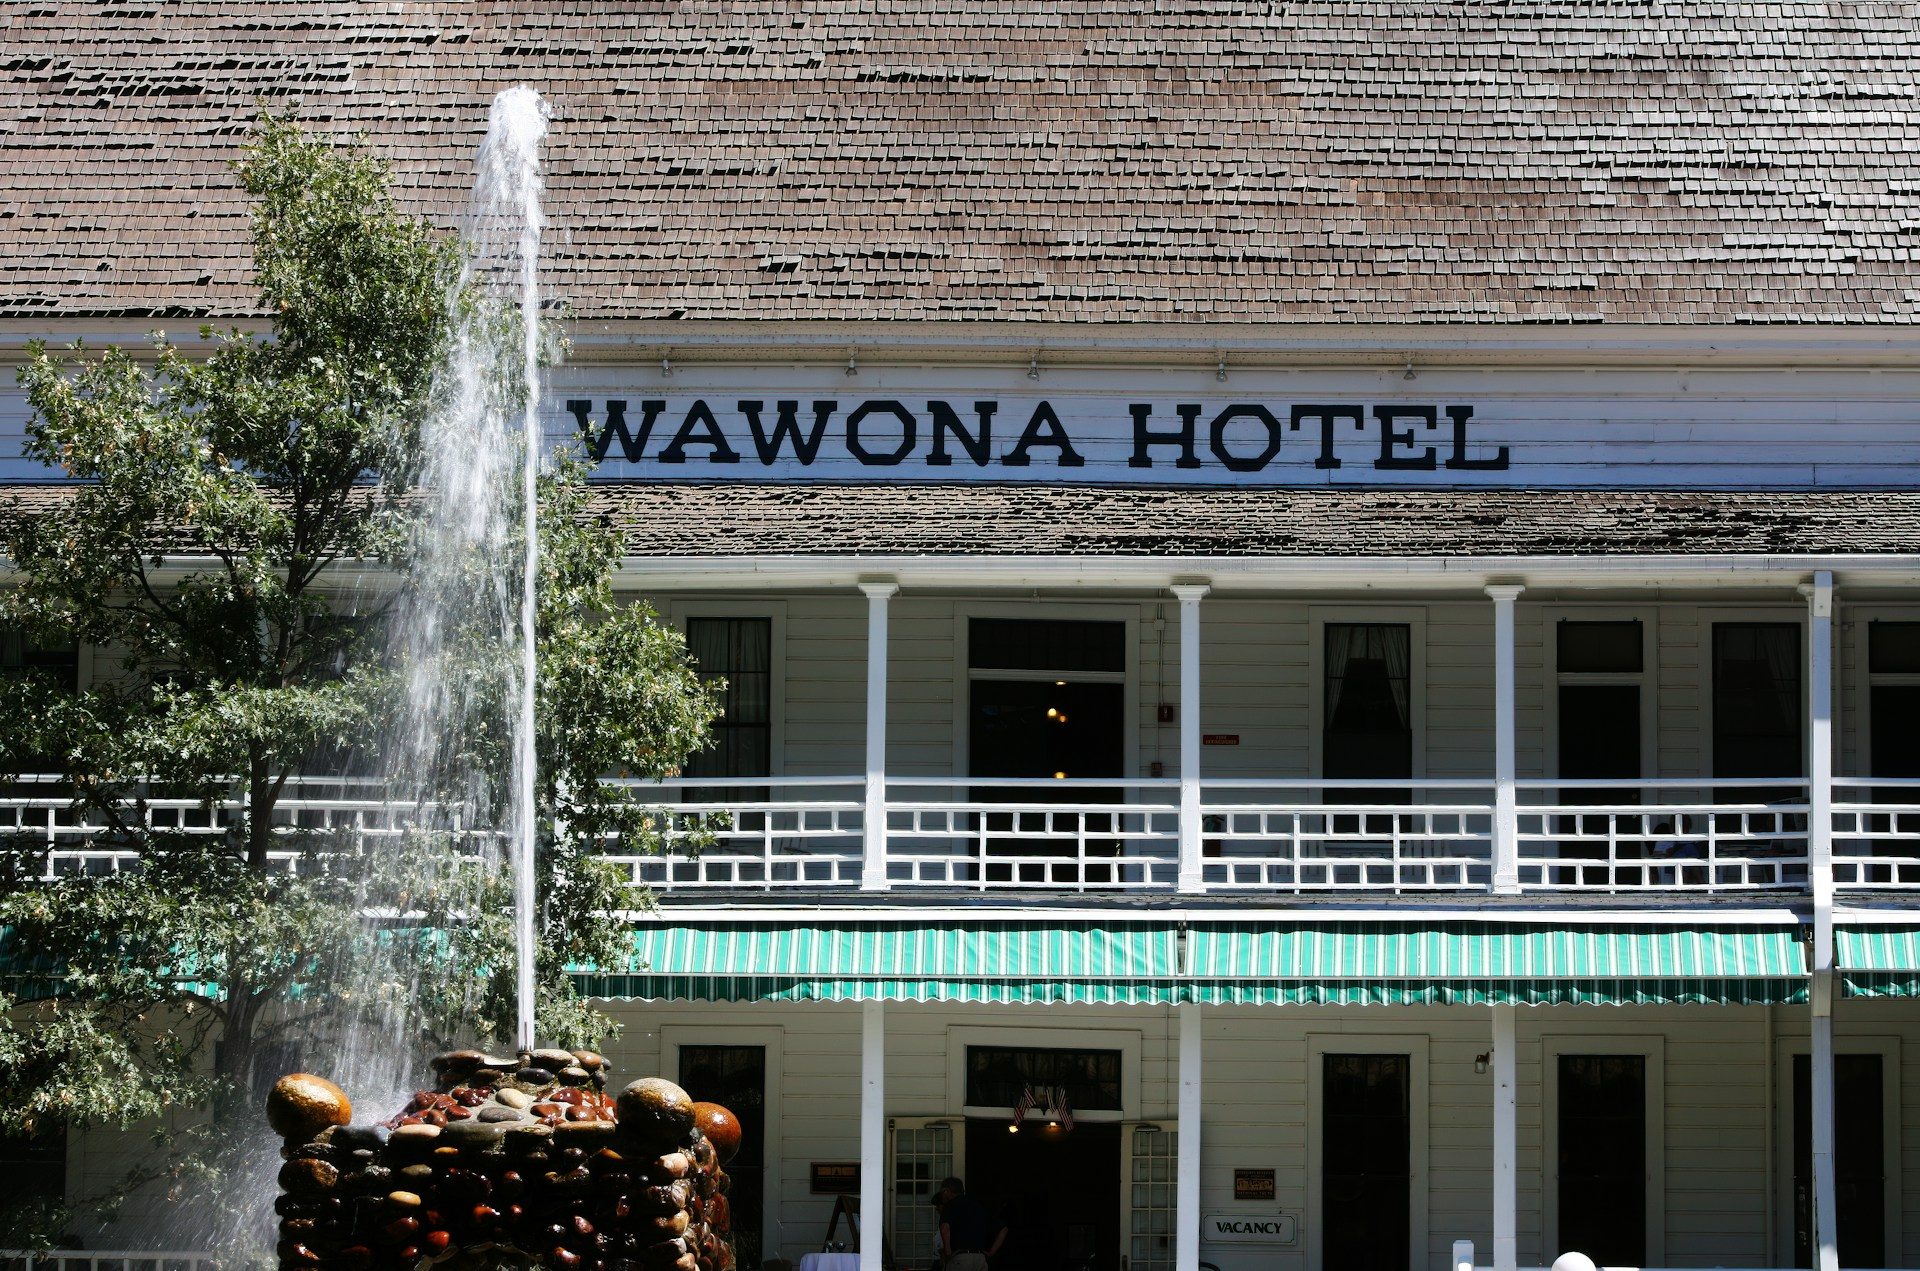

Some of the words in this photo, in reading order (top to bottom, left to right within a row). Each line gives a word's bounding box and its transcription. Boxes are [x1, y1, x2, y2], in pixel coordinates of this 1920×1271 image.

[566, 399, 1085, 467] WAWONA
[1128, 403, 1509, 472] HOTEL
[1216, 1221, 1282, 1234] VACANCY
